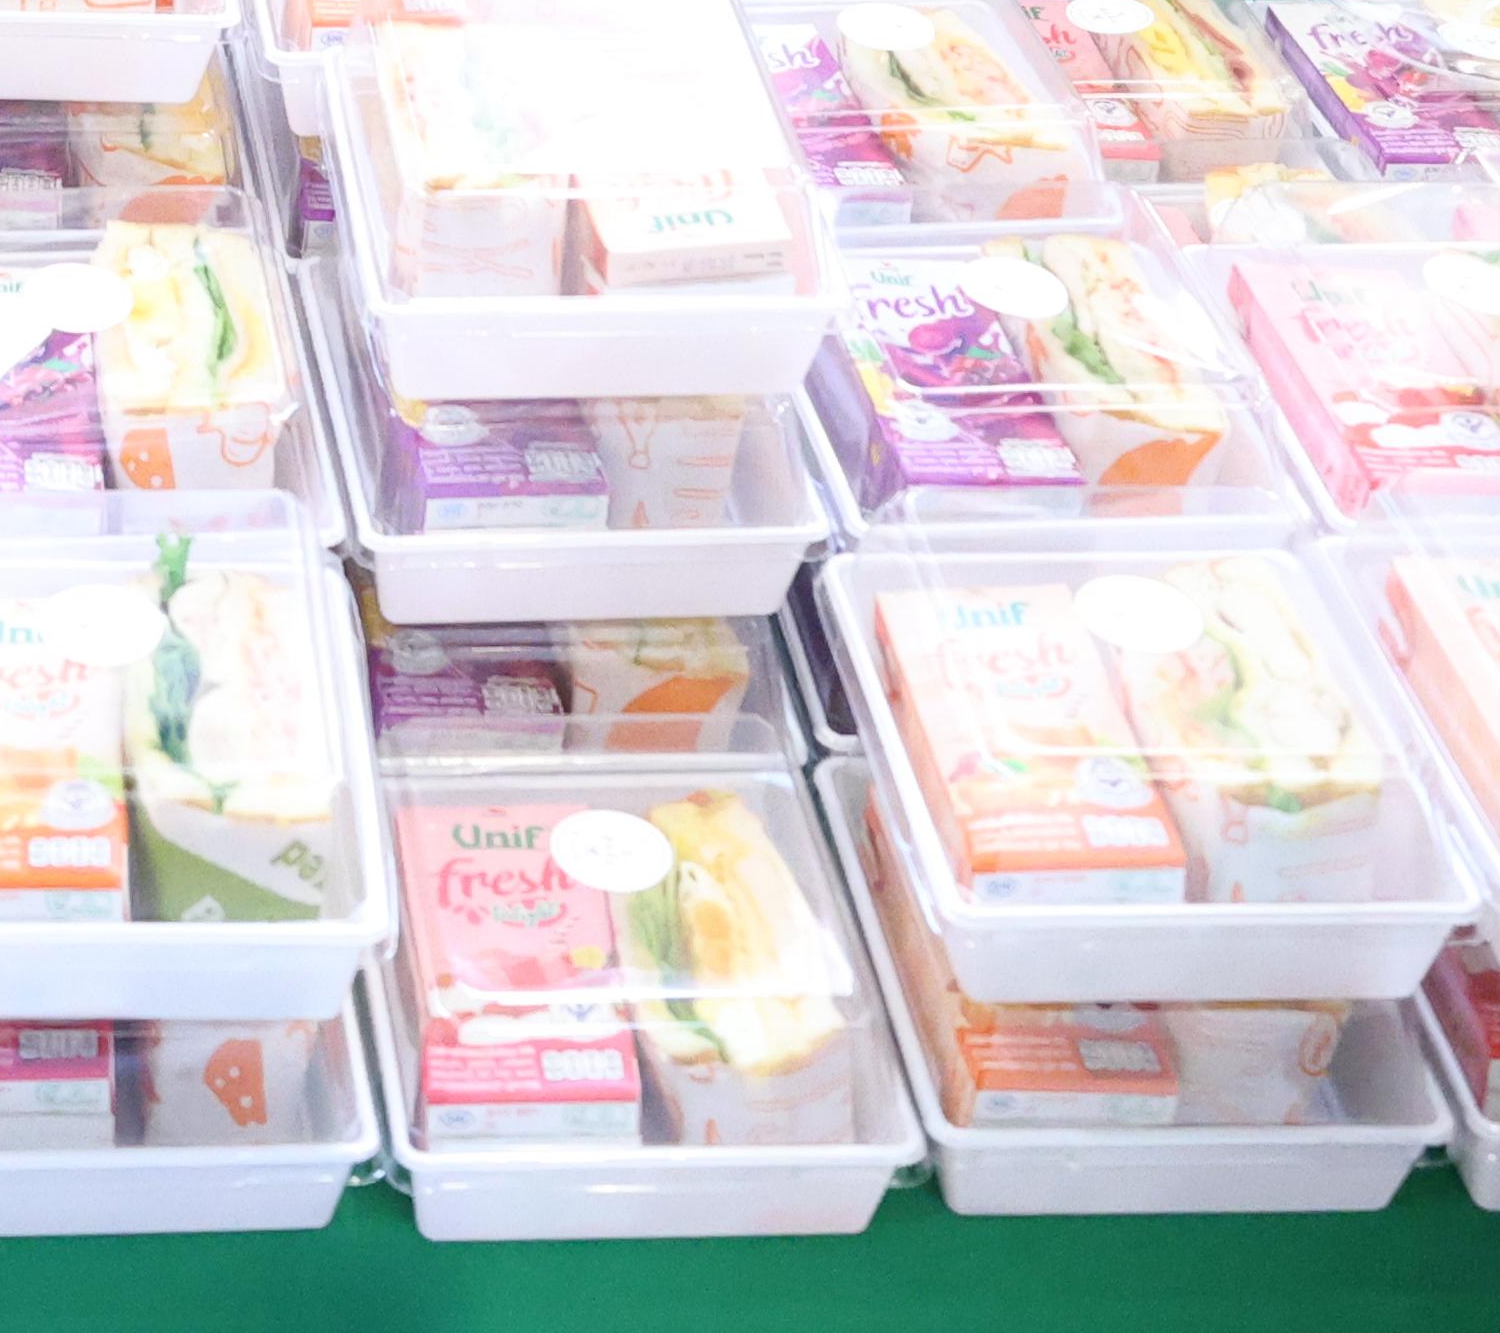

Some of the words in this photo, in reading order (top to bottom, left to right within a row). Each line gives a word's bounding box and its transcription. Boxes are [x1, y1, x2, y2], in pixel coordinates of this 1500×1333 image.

[647, 207, 737, 234] Unif
[452, 823, 542, 851] Unif
[436, 853, 580, 907] fresh
